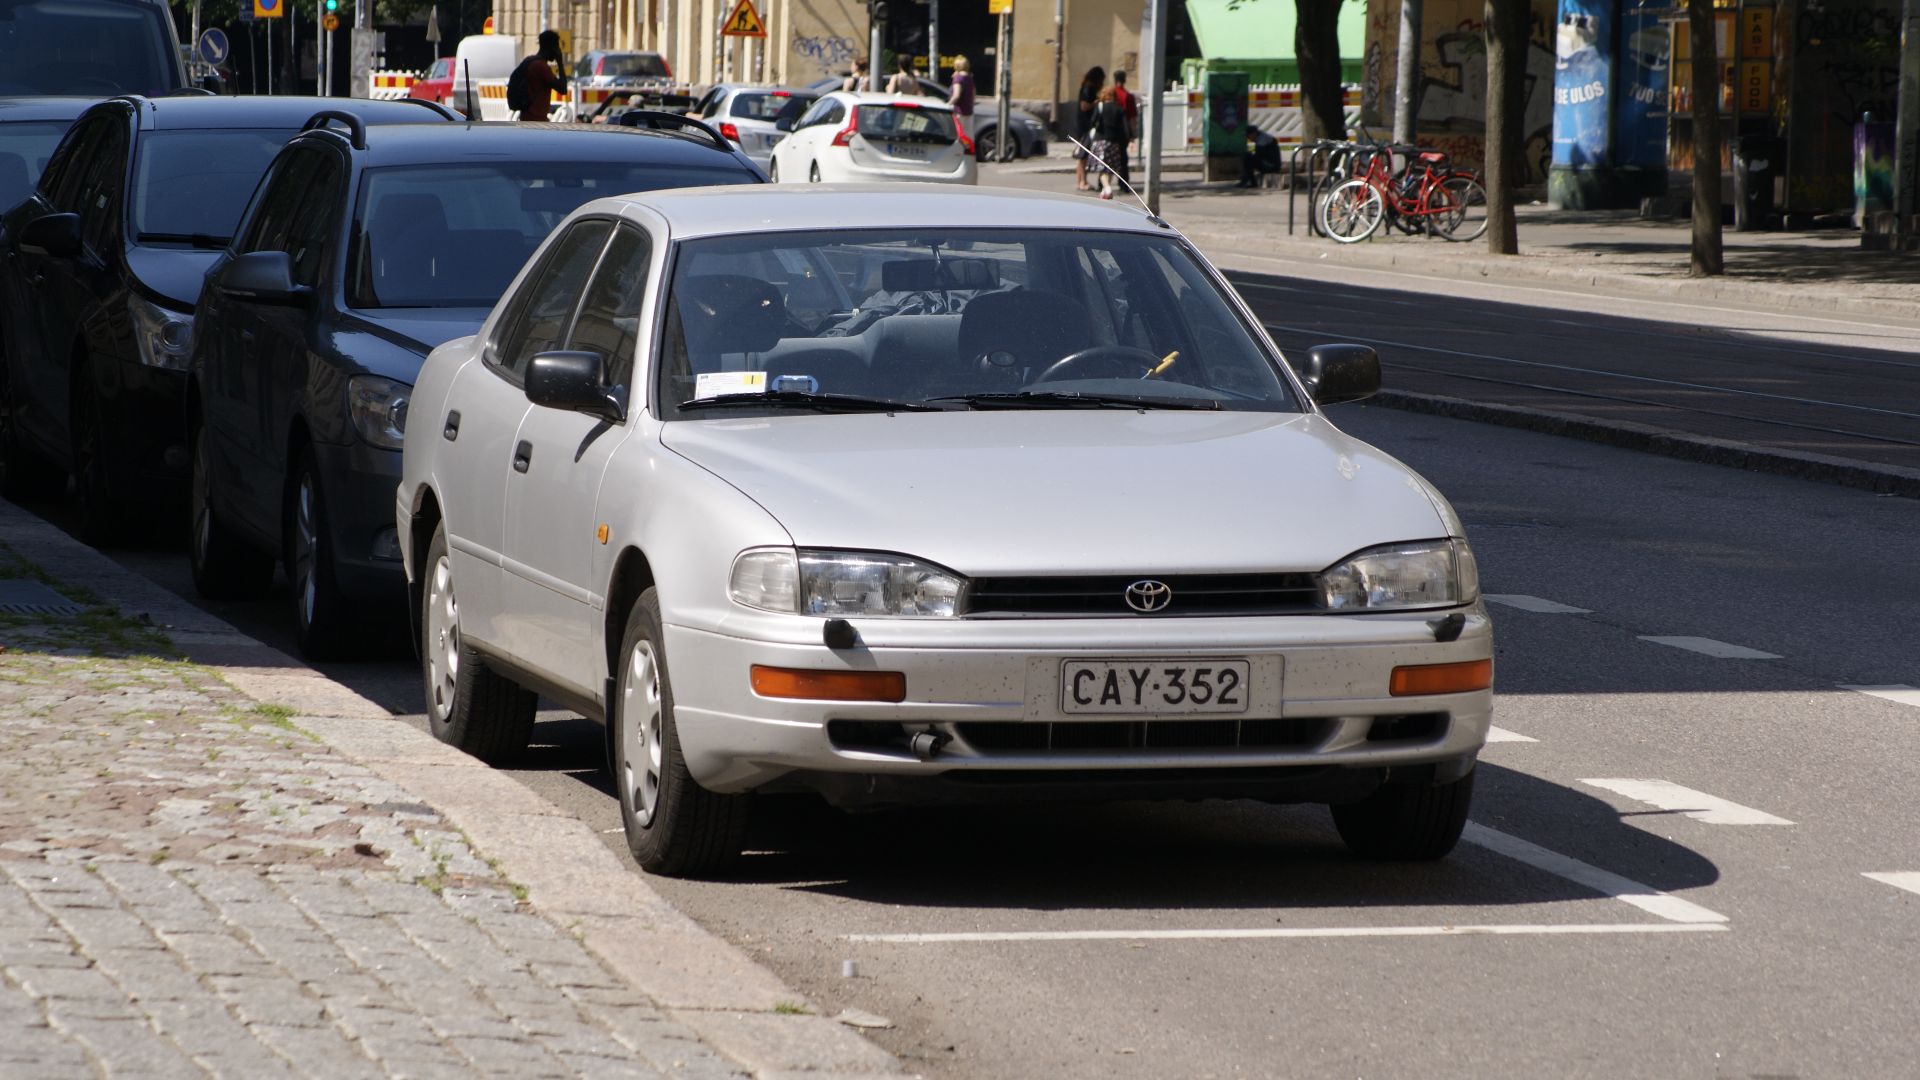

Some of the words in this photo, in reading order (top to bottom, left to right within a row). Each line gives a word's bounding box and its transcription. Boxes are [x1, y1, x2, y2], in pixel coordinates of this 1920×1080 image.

[1751, 12, 1763, 56] FAST
[1570, 80, 1605, 104] ULOS
[1749, 65, 1761, 108] FOOD
